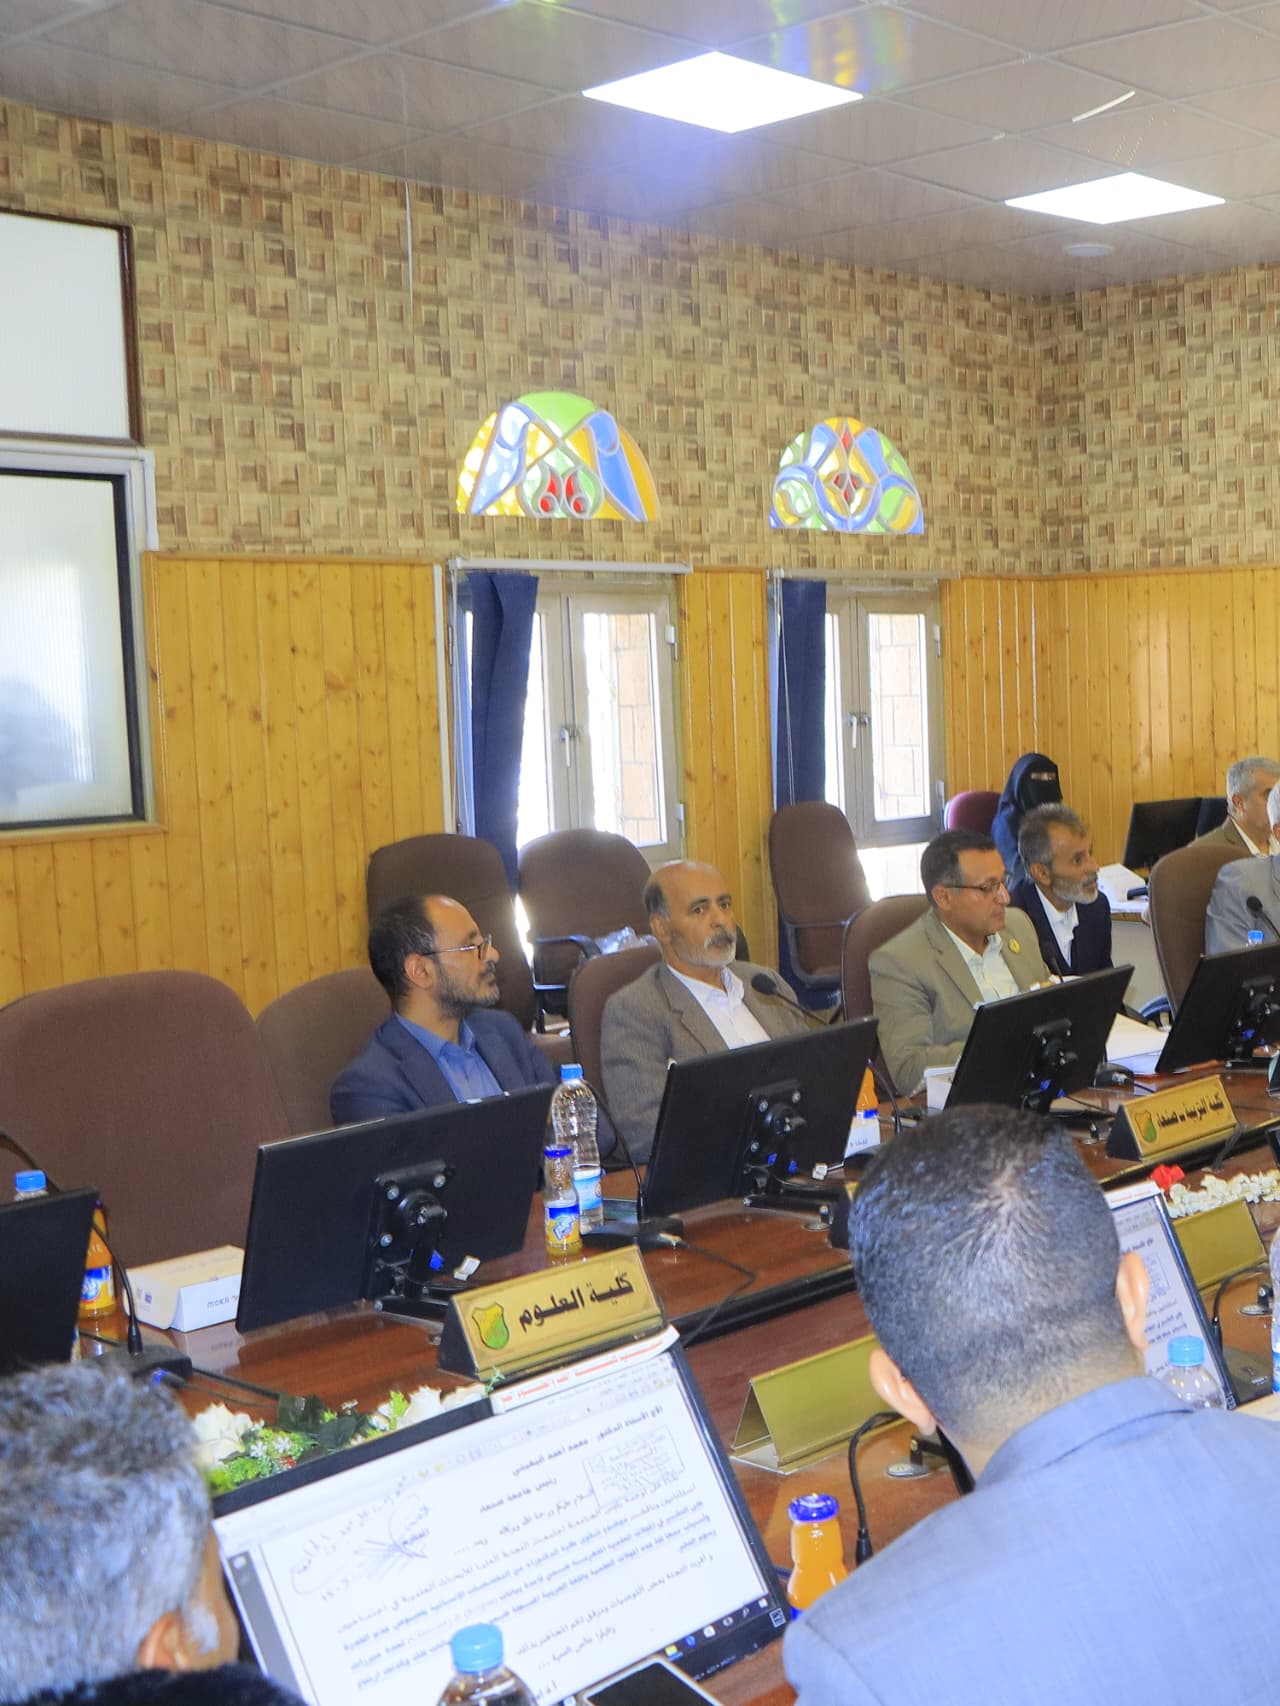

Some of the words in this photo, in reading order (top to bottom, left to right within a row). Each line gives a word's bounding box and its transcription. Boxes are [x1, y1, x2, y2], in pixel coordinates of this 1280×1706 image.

[1182, 1096, 1209, 1124] التربية
[1208, 1091, 1225, 1116] كلية
[1157, 1109, 1180, 1129] صنعاء
[590, 1271, 634, 1304] كلية
[519, 1285, 586, 1334] العلوم
